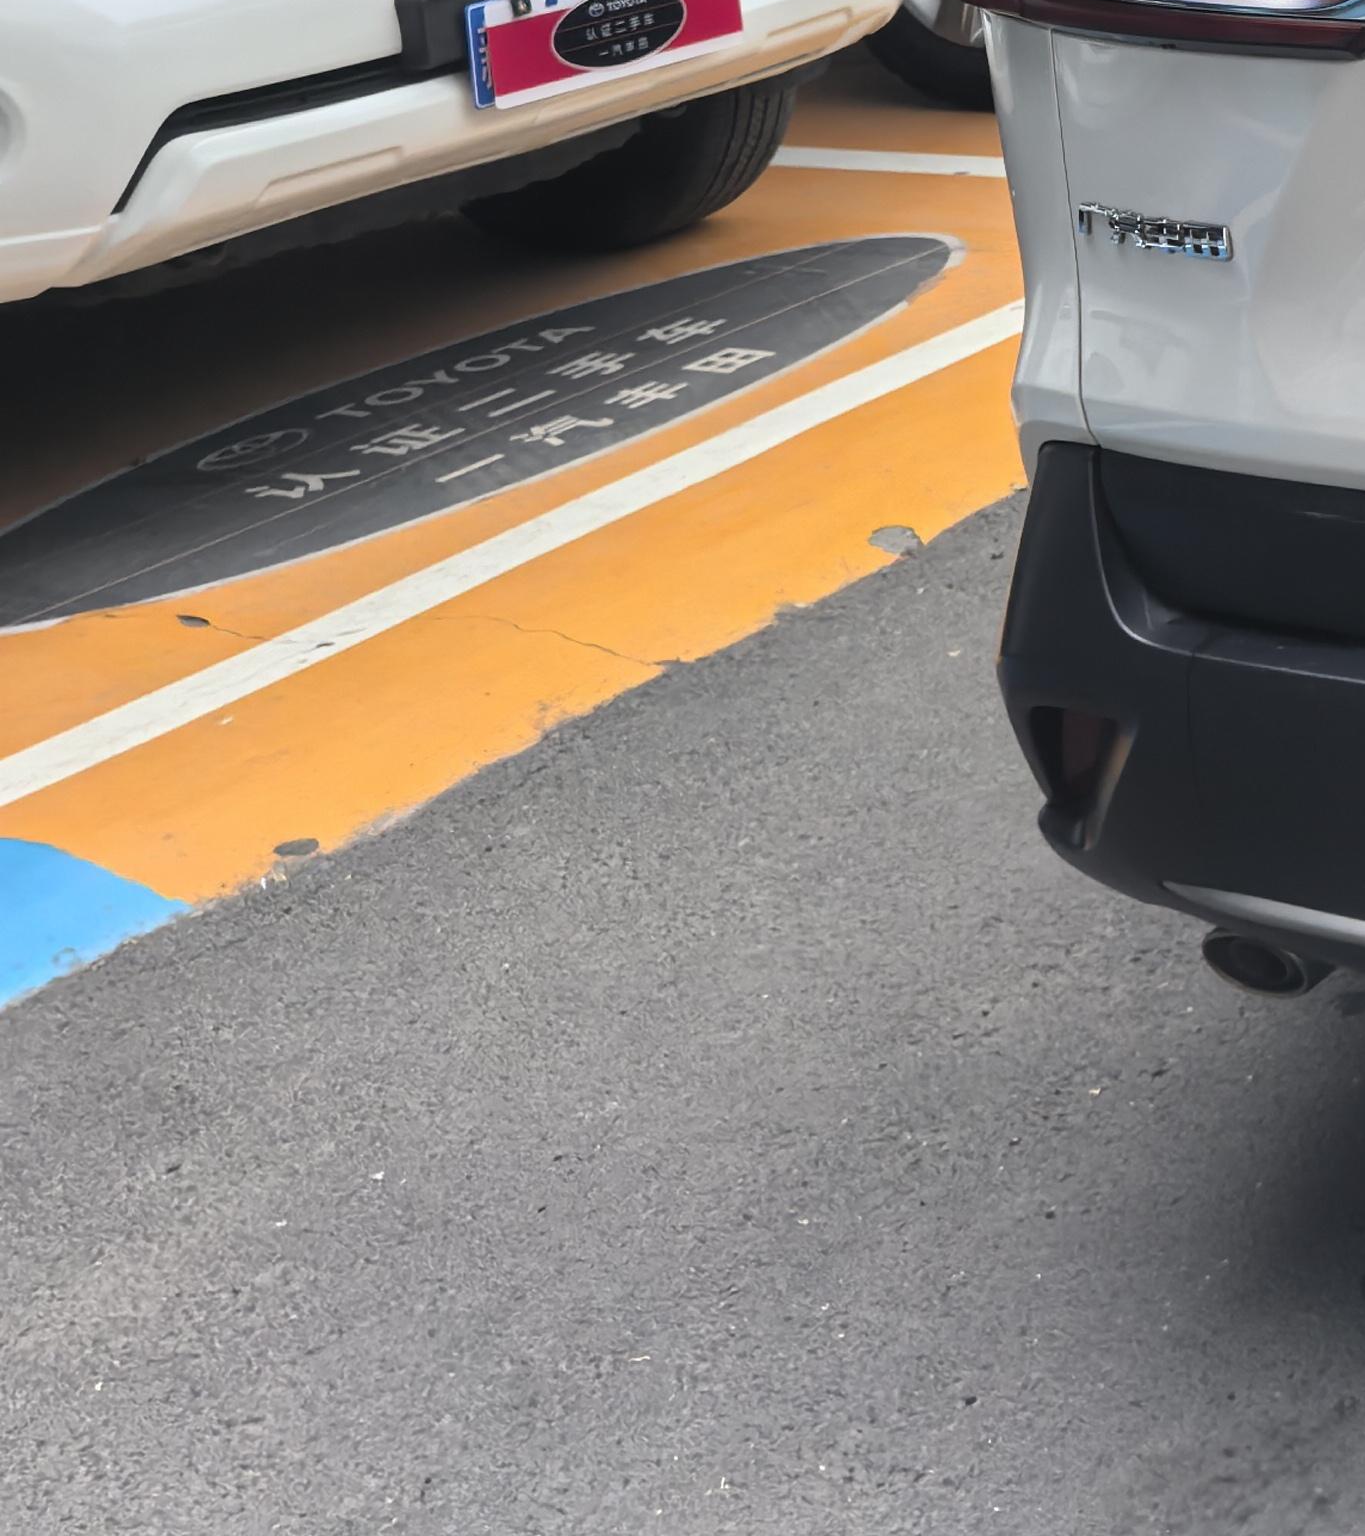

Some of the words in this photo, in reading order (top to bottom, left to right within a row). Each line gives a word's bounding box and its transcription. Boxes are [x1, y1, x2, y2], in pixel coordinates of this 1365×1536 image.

[245, 317, 727, 500] 认证二手车
[318, 325, 596, 420] TOYOTA
[435, 347, 778, 484] 一汽丰田
